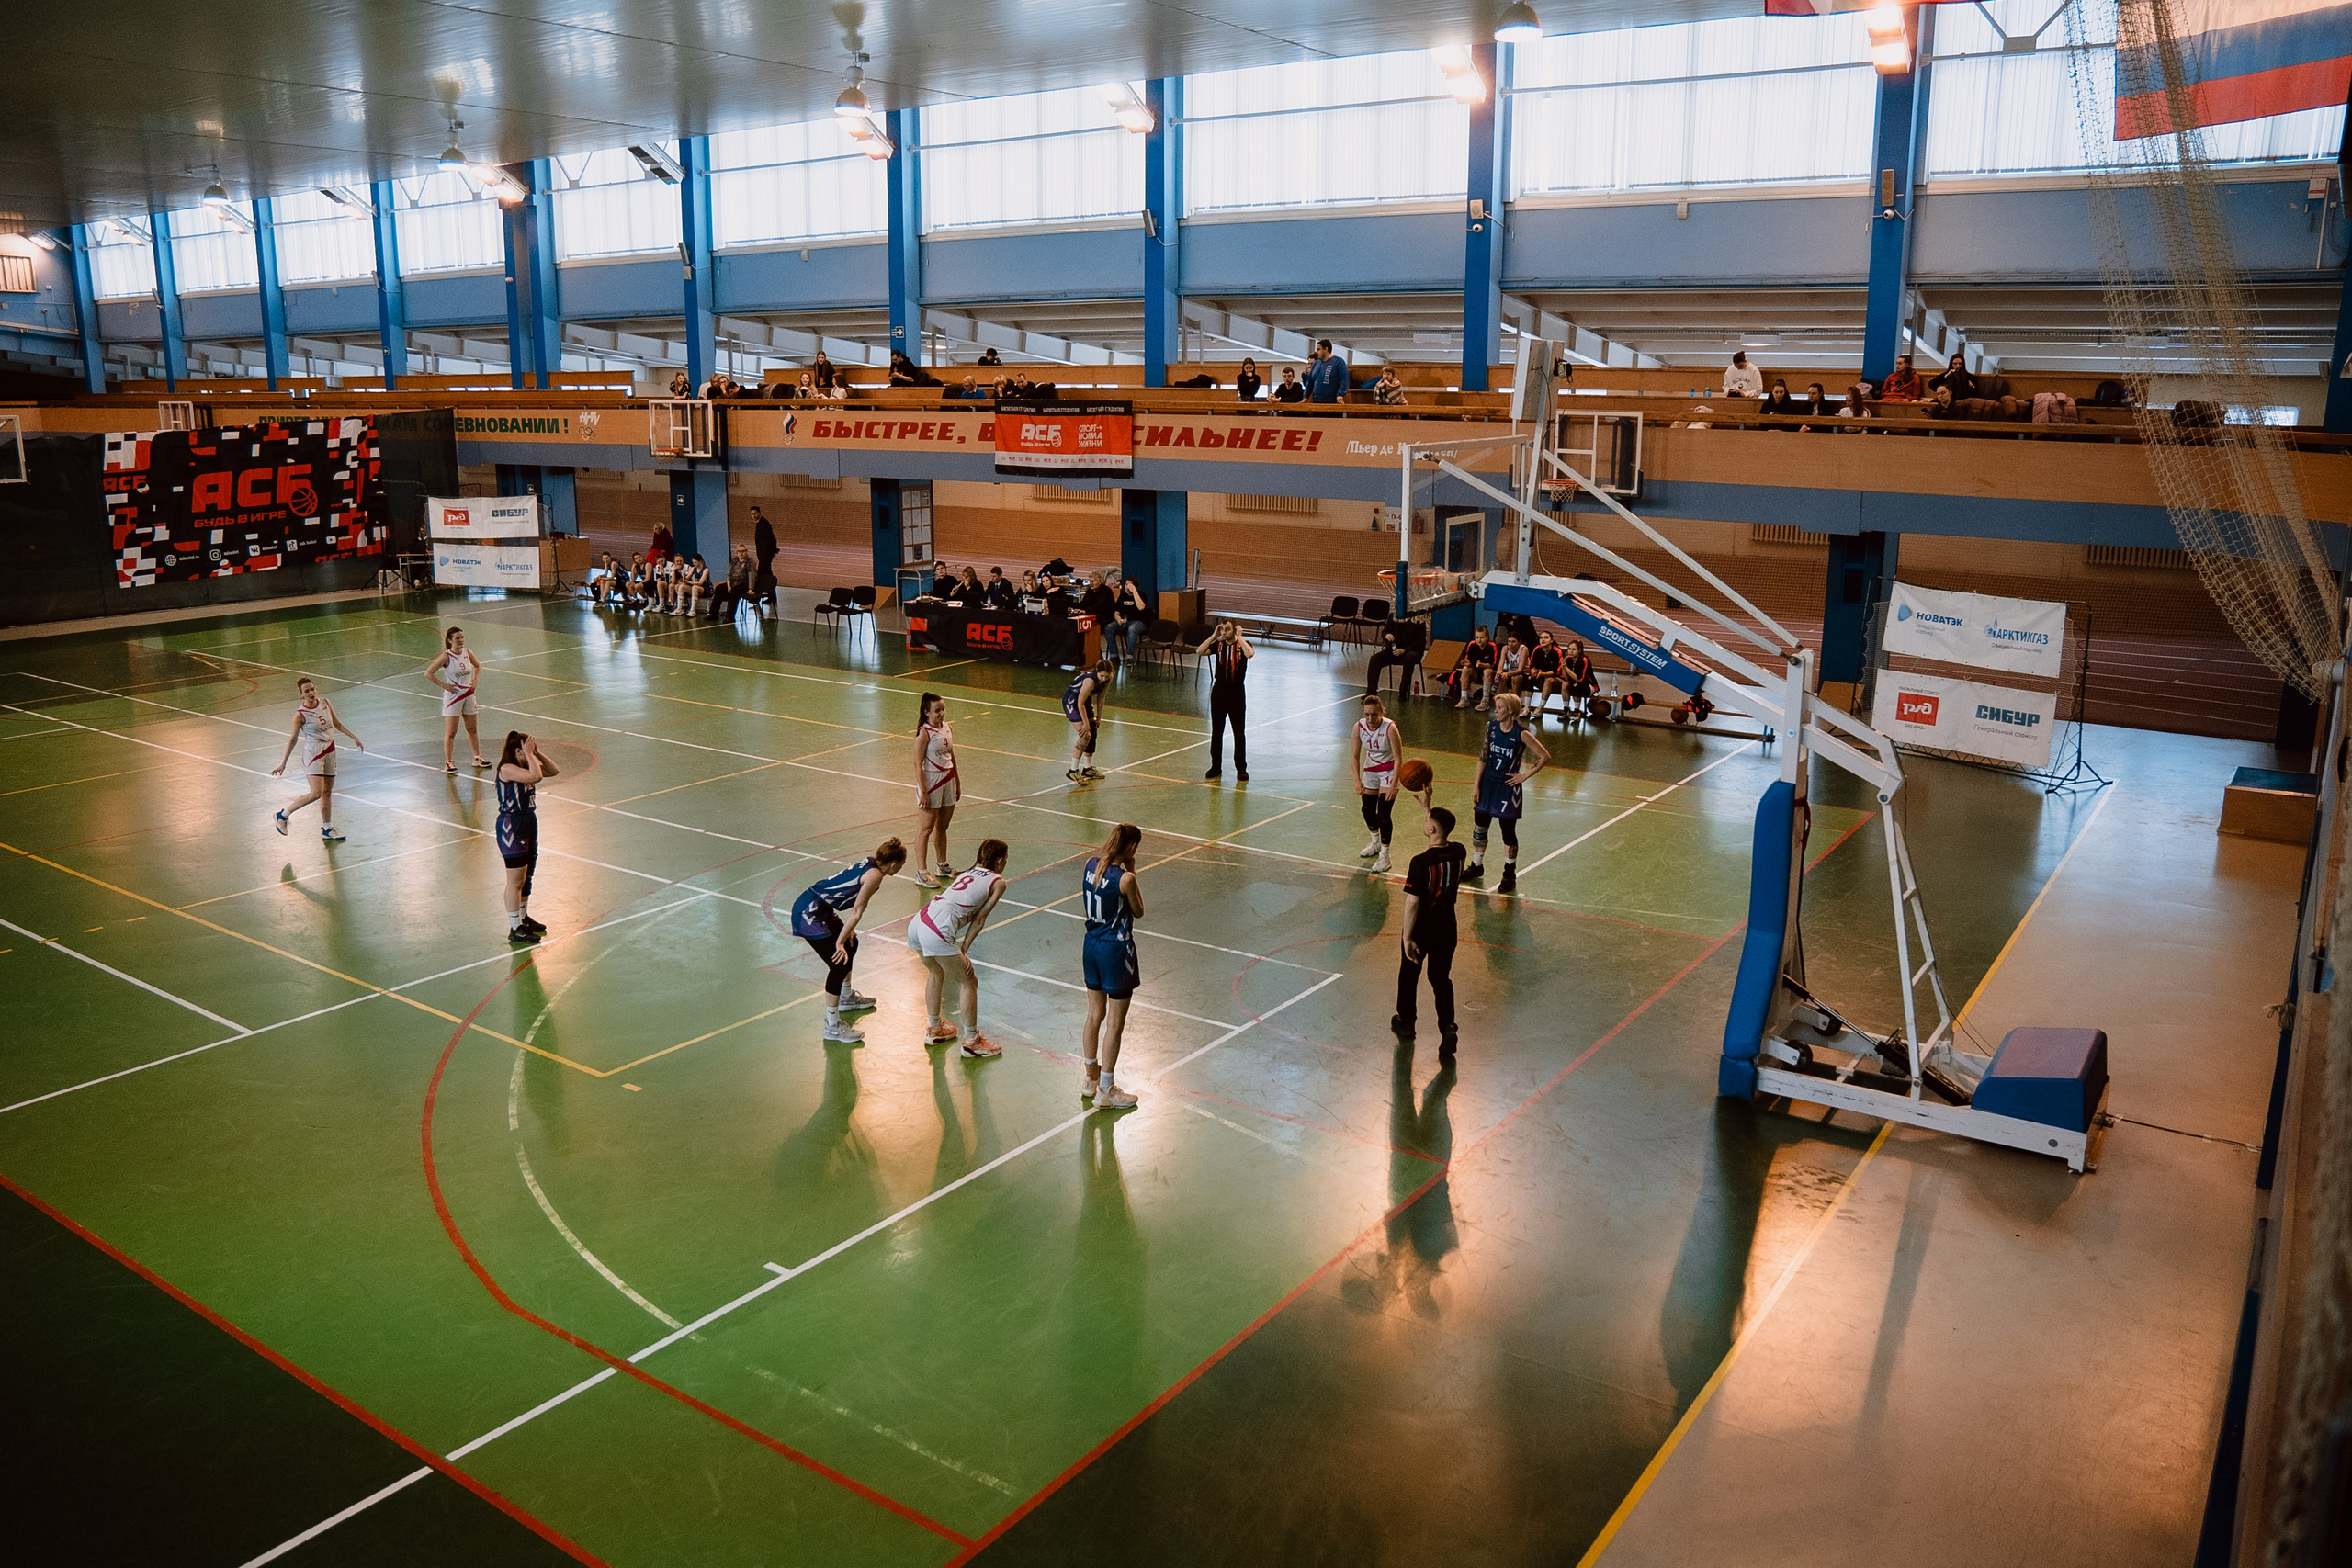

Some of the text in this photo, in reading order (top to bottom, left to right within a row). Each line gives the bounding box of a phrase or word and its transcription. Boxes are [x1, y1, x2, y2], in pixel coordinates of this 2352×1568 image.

[812, 420, 967, 444] БЫСТРЕЕ,
[1021, 423, 1062, 442] АСБ
[1380, 445, 1394, 456] де
[103, 475, 147, 491] АСБ
[191, 463, 312, 513] АСБ
[194, 510, 287, 528] БУДЬ В ИГРЕ
[492, 508, 528, 517] СИБУР
[1917, 612, 1963, 627] НОВАТЭК
[967, 623, 1012, 642] АСБ
[1996, 628, 2049, 645] АРКТИКГАЗ
[1599, 625, 1668, 668] SPORT SYSTEM
[318, 715, 326, 726] 5
[1975, 705, 2041, 727] СИБУР
[1973, 723, 2039, 741] Генеральный спонсор
[943, 737, 949, 748] 4
[1366, 739, 1380, 750] 14
[1495, 758, 1503, 771] 7
[1500, 800, 1509, 813] 7
[967, 868, 991, 878] ГПУ
[951, 875, 974, 891] 8
[1086, 890, 1106, 924] 11
